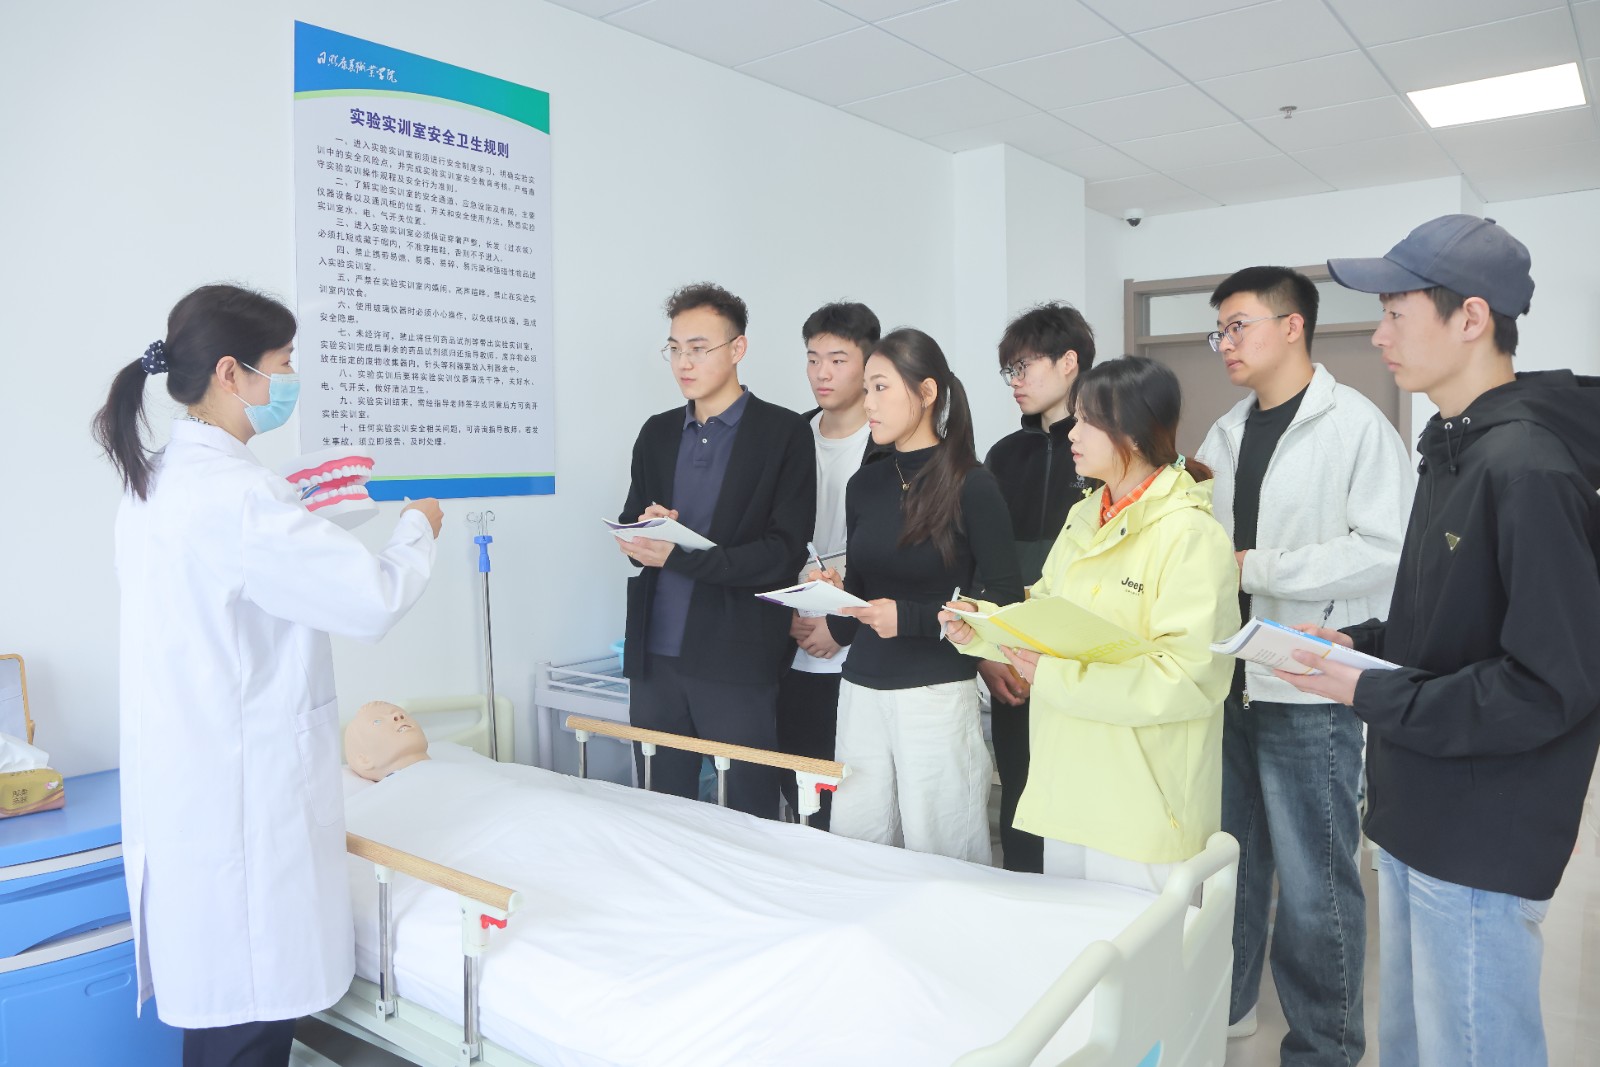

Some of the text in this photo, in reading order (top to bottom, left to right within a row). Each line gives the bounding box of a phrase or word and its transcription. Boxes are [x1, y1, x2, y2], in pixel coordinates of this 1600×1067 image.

[350, 108, 510, 159] 实验实训室安全卫生规则
[1121, 577, 1144, 593] Jeep
